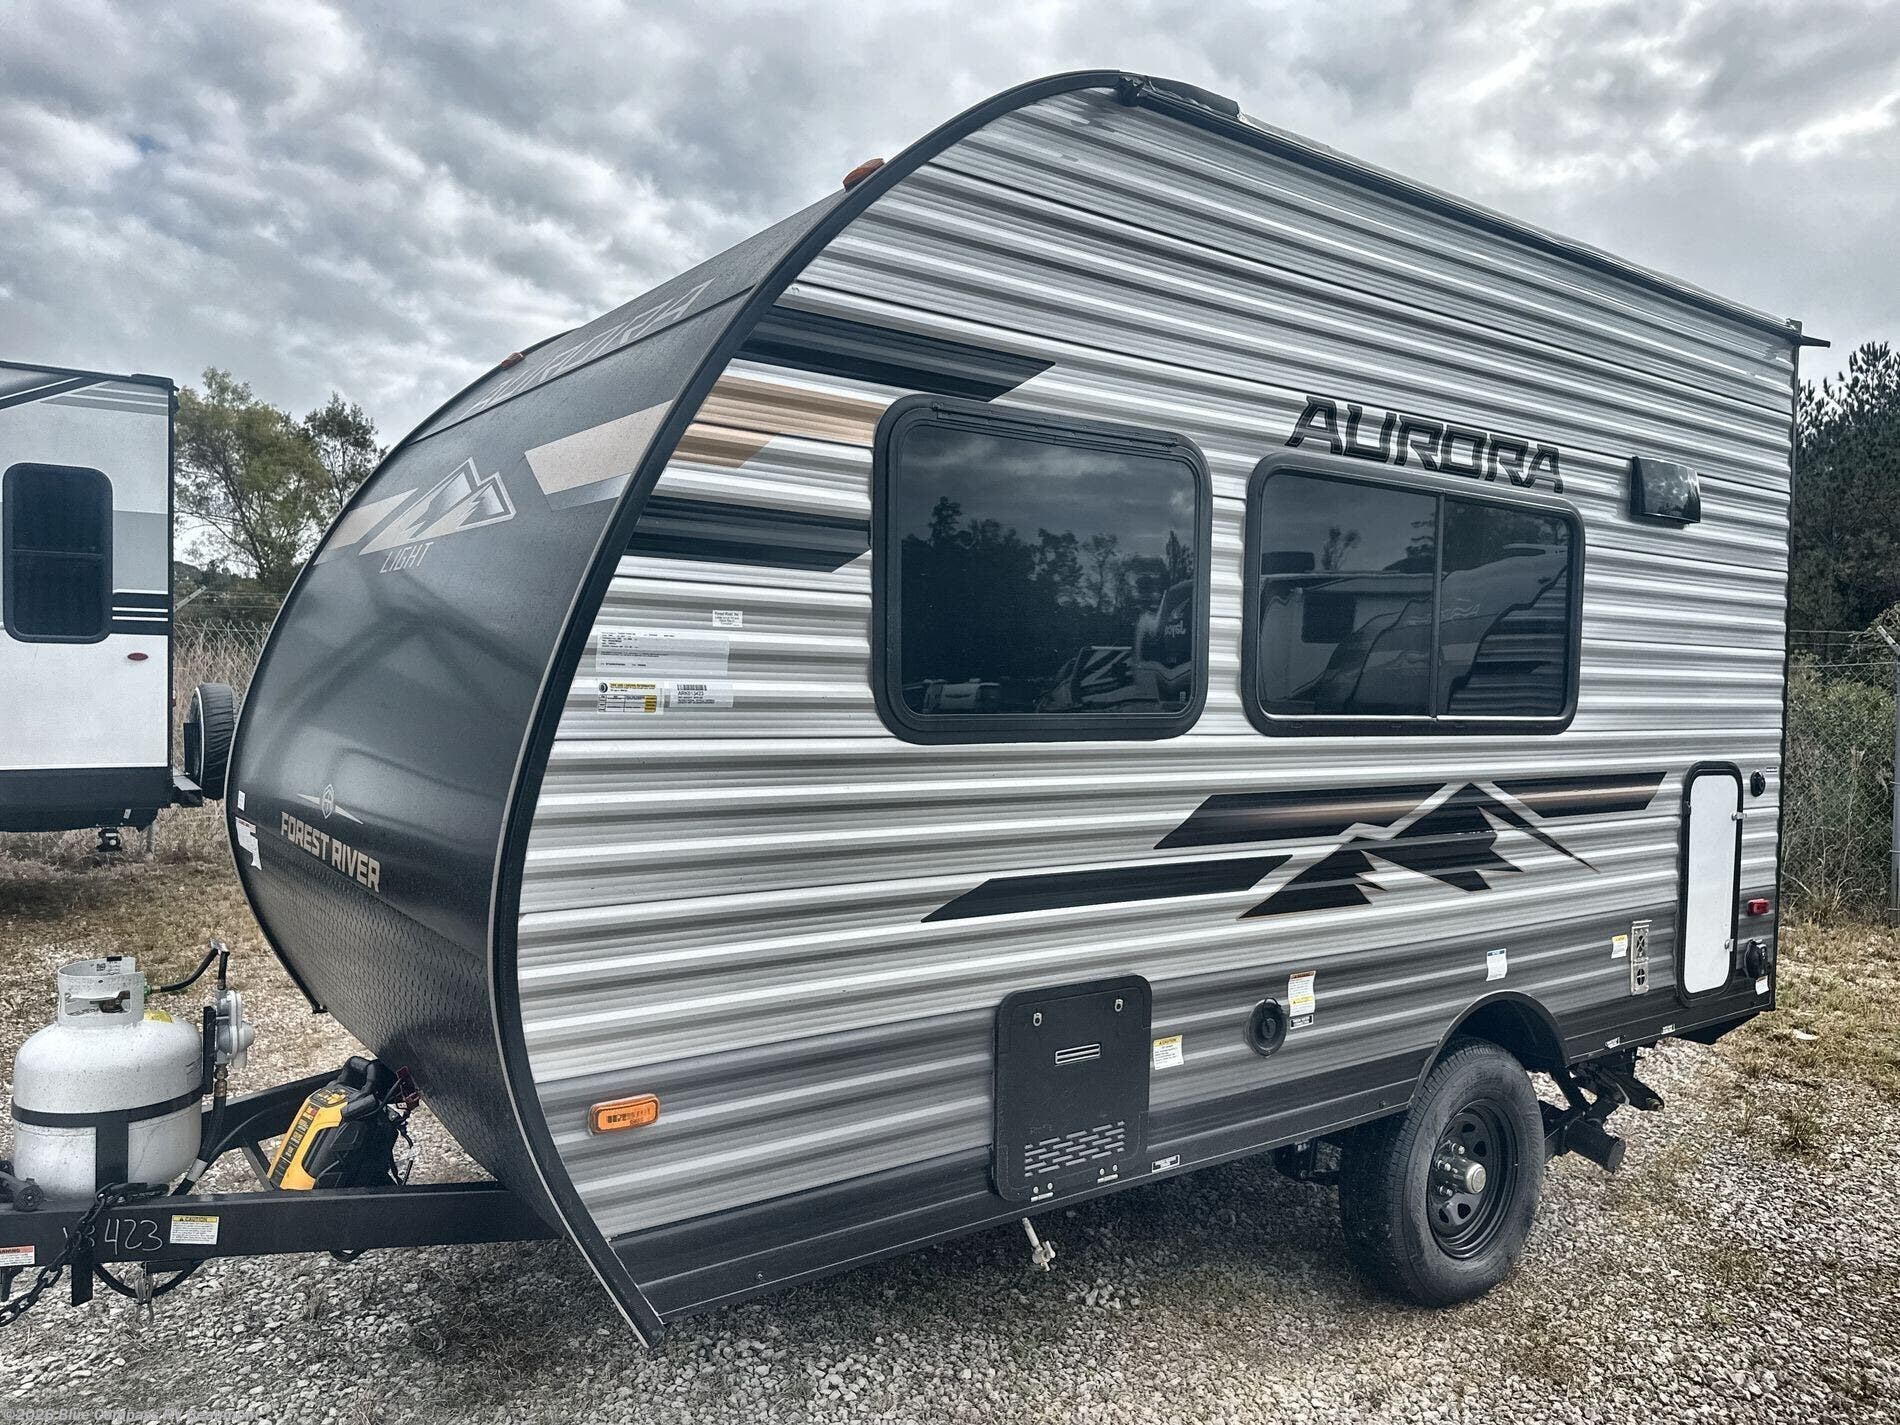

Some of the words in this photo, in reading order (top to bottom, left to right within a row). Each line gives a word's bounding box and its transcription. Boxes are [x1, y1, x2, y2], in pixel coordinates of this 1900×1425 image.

[1284, 395, 1564, 494] AURORA
[379, 541, 434, 574] LIGHT
[280, 811, 330, 861] FOREST
[331, 837, 381, 893] RIVER
